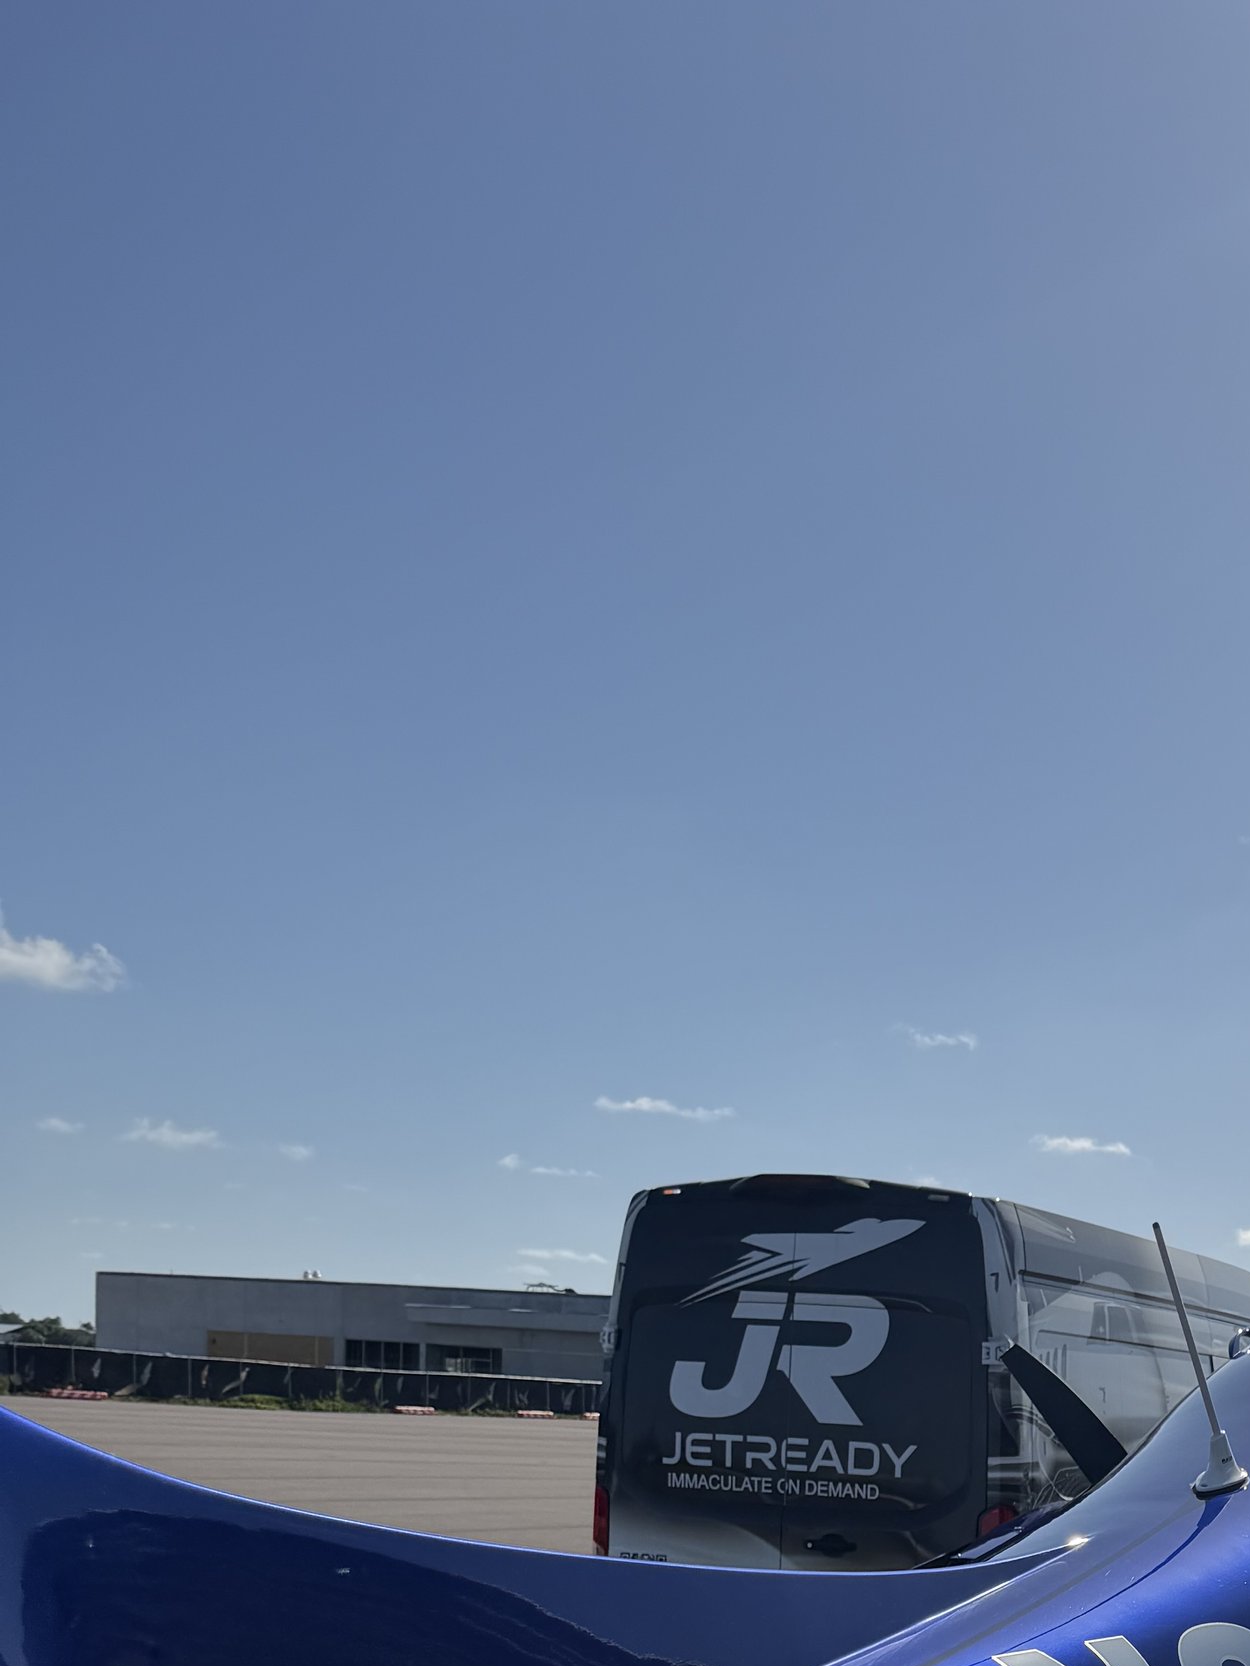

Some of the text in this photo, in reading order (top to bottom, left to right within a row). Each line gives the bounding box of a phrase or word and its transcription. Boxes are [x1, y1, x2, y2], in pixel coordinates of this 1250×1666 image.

[669, 1290, 890, 1427] JR
[662, 1432, 918, 1478] JETREADY
[667, 1472, 880, 1500] IMMACULATE ON DEMAND
